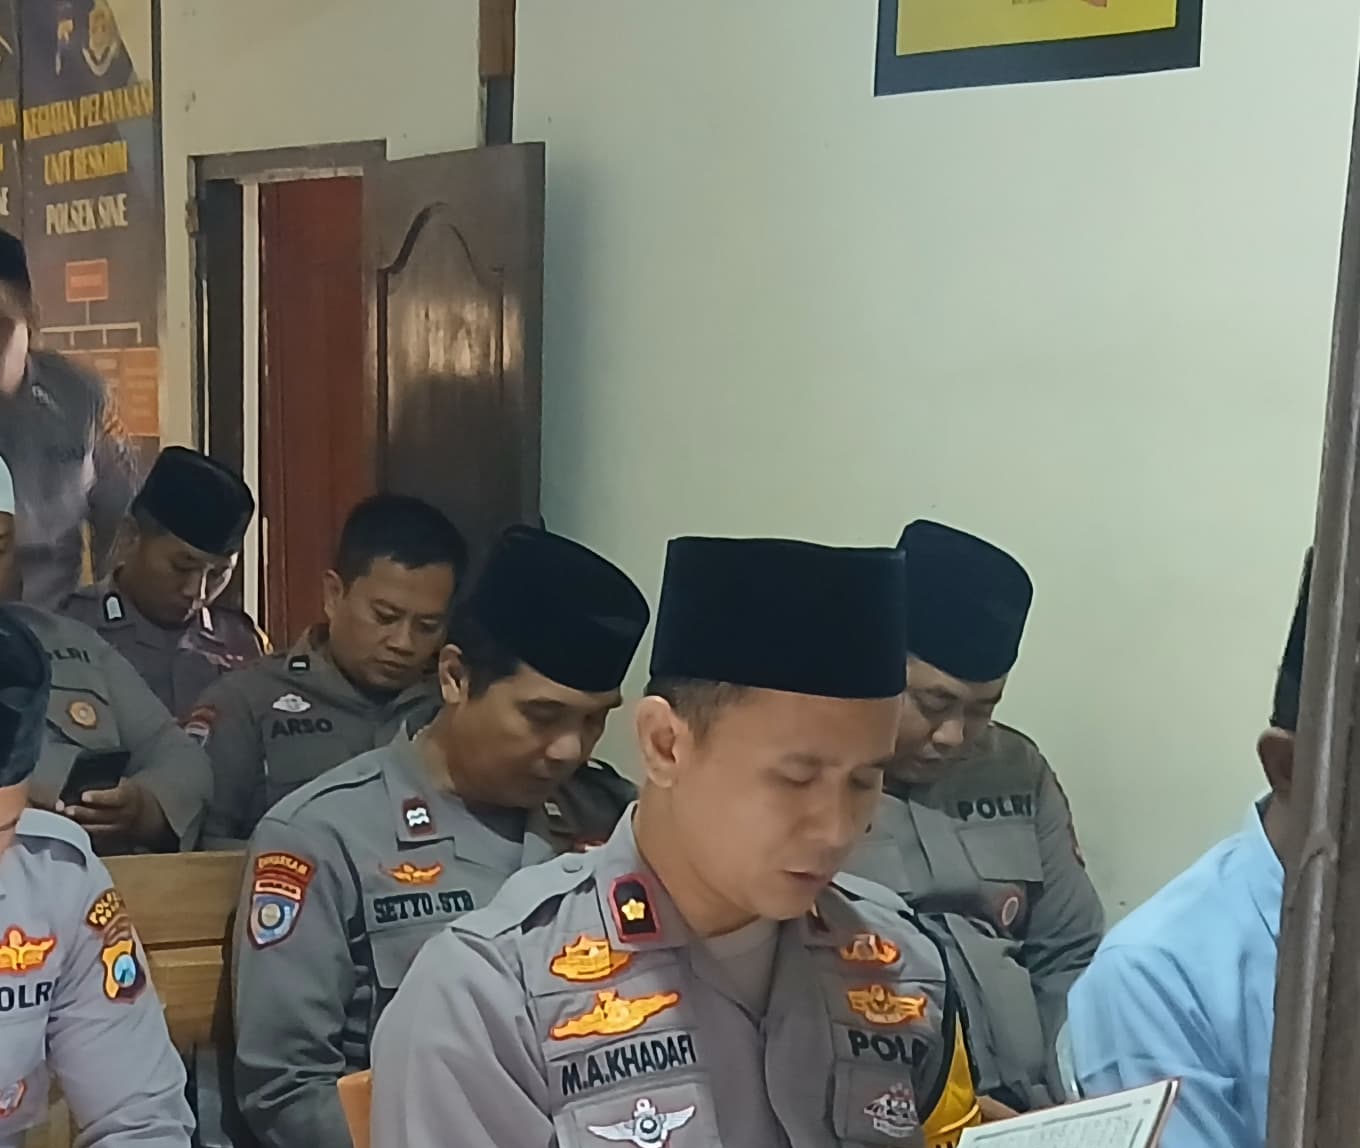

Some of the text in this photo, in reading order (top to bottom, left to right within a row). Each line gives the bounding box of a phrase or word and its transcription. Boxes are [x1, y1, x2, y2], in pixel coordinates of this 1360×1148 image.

[46, 193, 128, 235] POLSEK SINE
[271, 718, 333, 739] ARSO
[957, 794, 1032, 821] POLRI
[562, 1034, 697, 1096] M.A.KHADAFI
